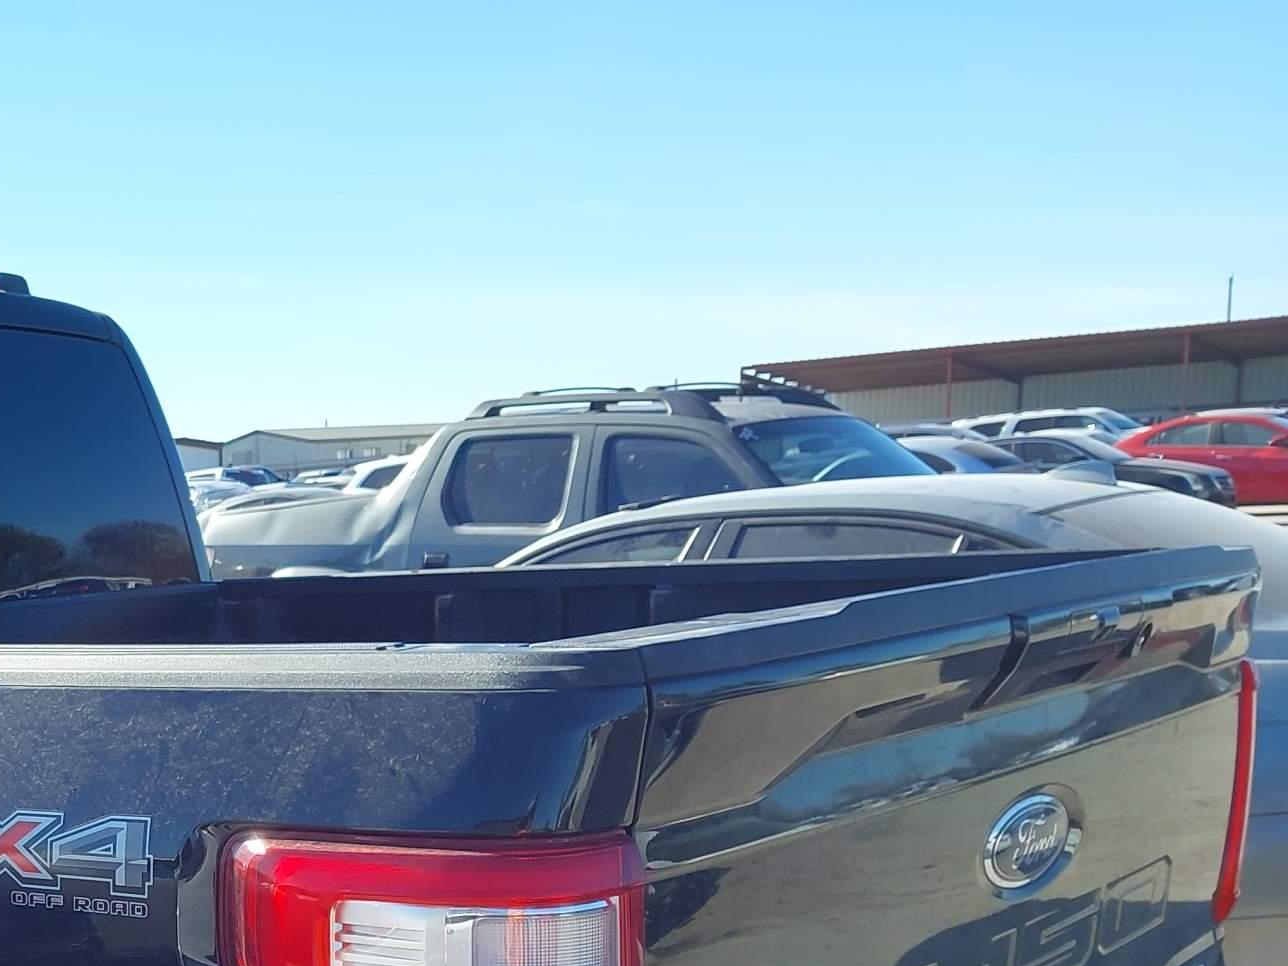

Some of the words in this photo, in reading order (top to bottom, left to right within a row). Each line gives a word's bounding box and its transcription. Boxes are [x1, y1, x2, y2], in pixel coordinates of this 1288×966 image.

[1011, 813, 1059, 870] Ford
[11, 891, 64, 908] OFF
[73, 897, 149, 918] ROAD
